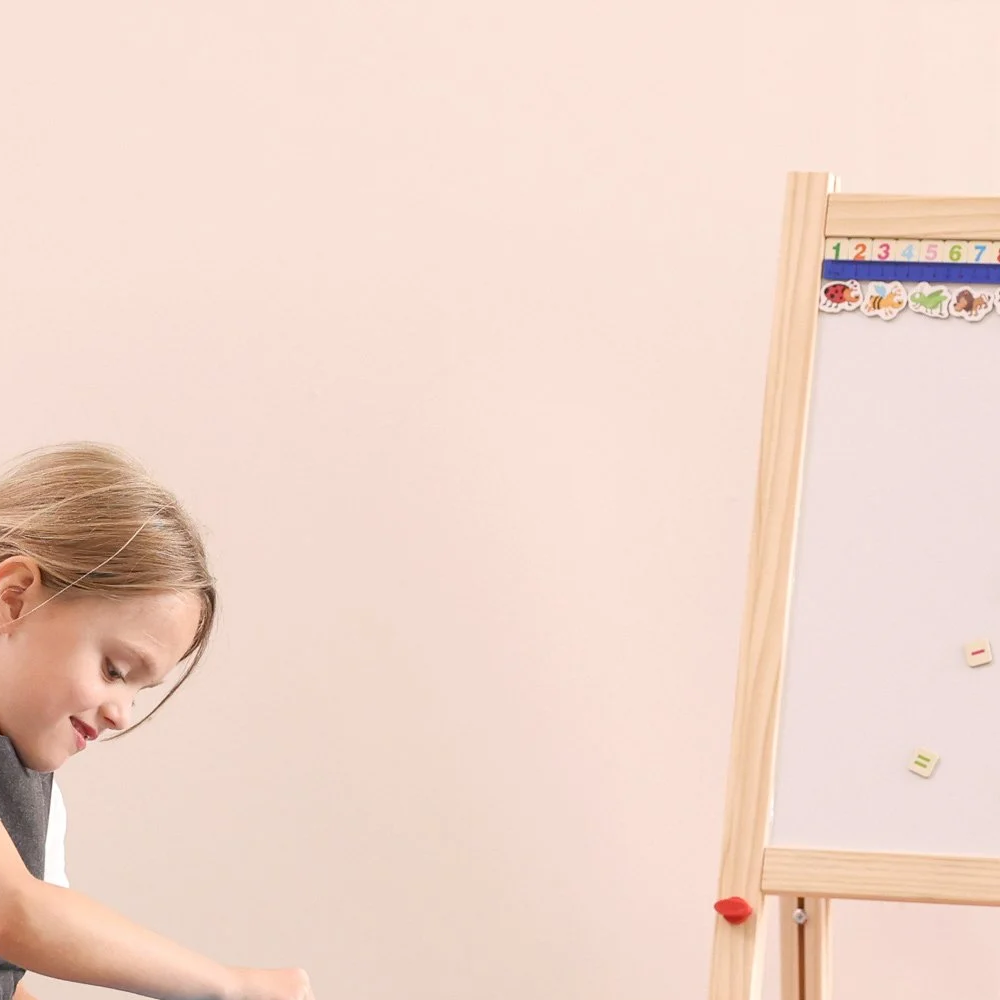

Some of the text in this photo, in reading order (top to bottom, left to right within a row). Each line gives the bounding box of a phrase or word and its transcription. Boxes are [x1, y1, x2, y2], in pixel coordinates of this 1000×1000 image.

[832, 242, 841, 260] 1
[854, 243, 867, 260] 2
[877, 243, 890, 260] 3
[901, 243, 914, 260] 4
[925, 244, 938, 260] 5
[949, 244, 962, 261] 6
[974, 245, 987, 262] 7
